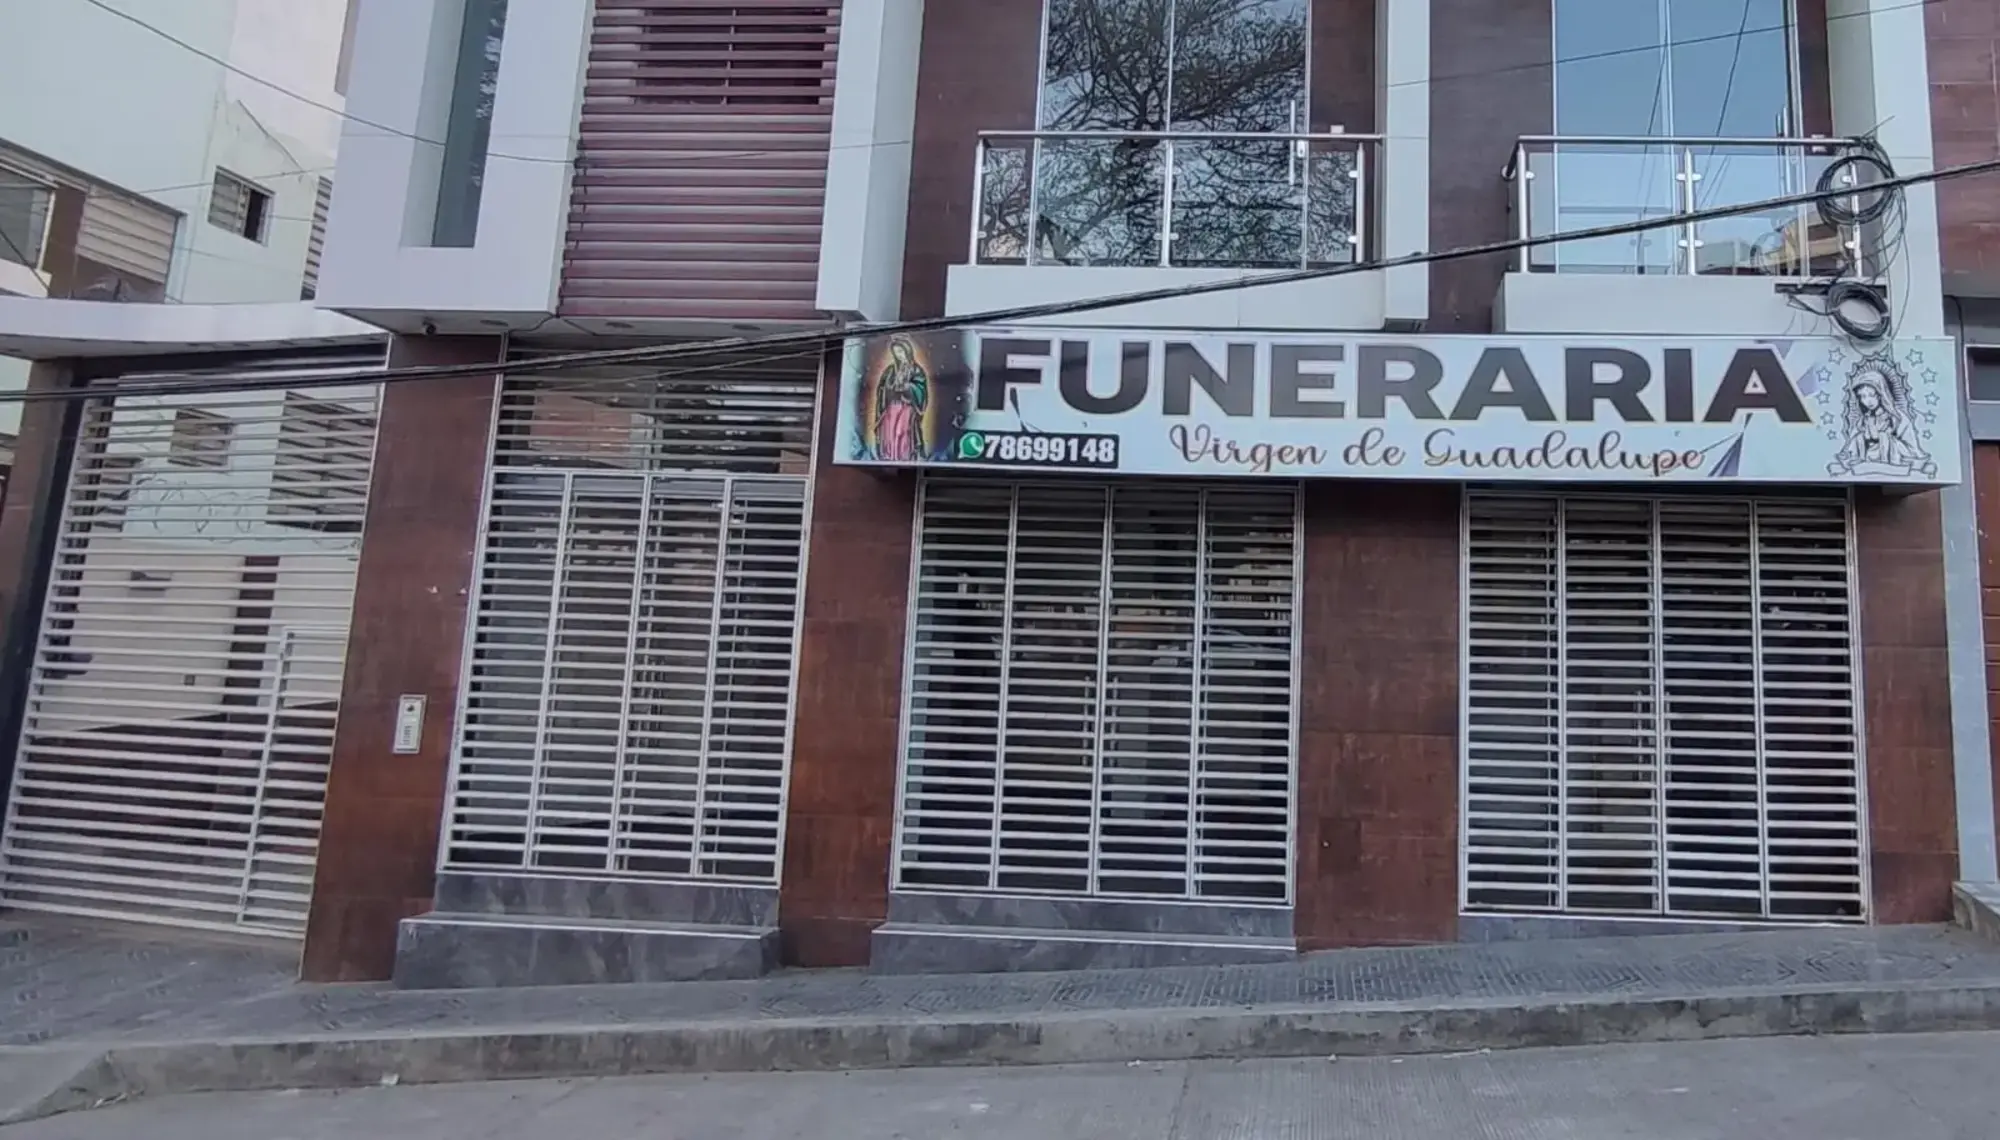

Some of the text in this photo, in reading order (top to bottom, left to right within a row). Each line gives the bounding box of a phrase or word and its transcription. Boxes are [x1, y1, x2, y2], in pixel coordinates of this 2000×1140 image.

[977, 338, 1812, 423] FUNERARIA
[985, 435, 1115, 464] 78699148
[1169, 423, 1705, 477] Virgen de Guadalupe
